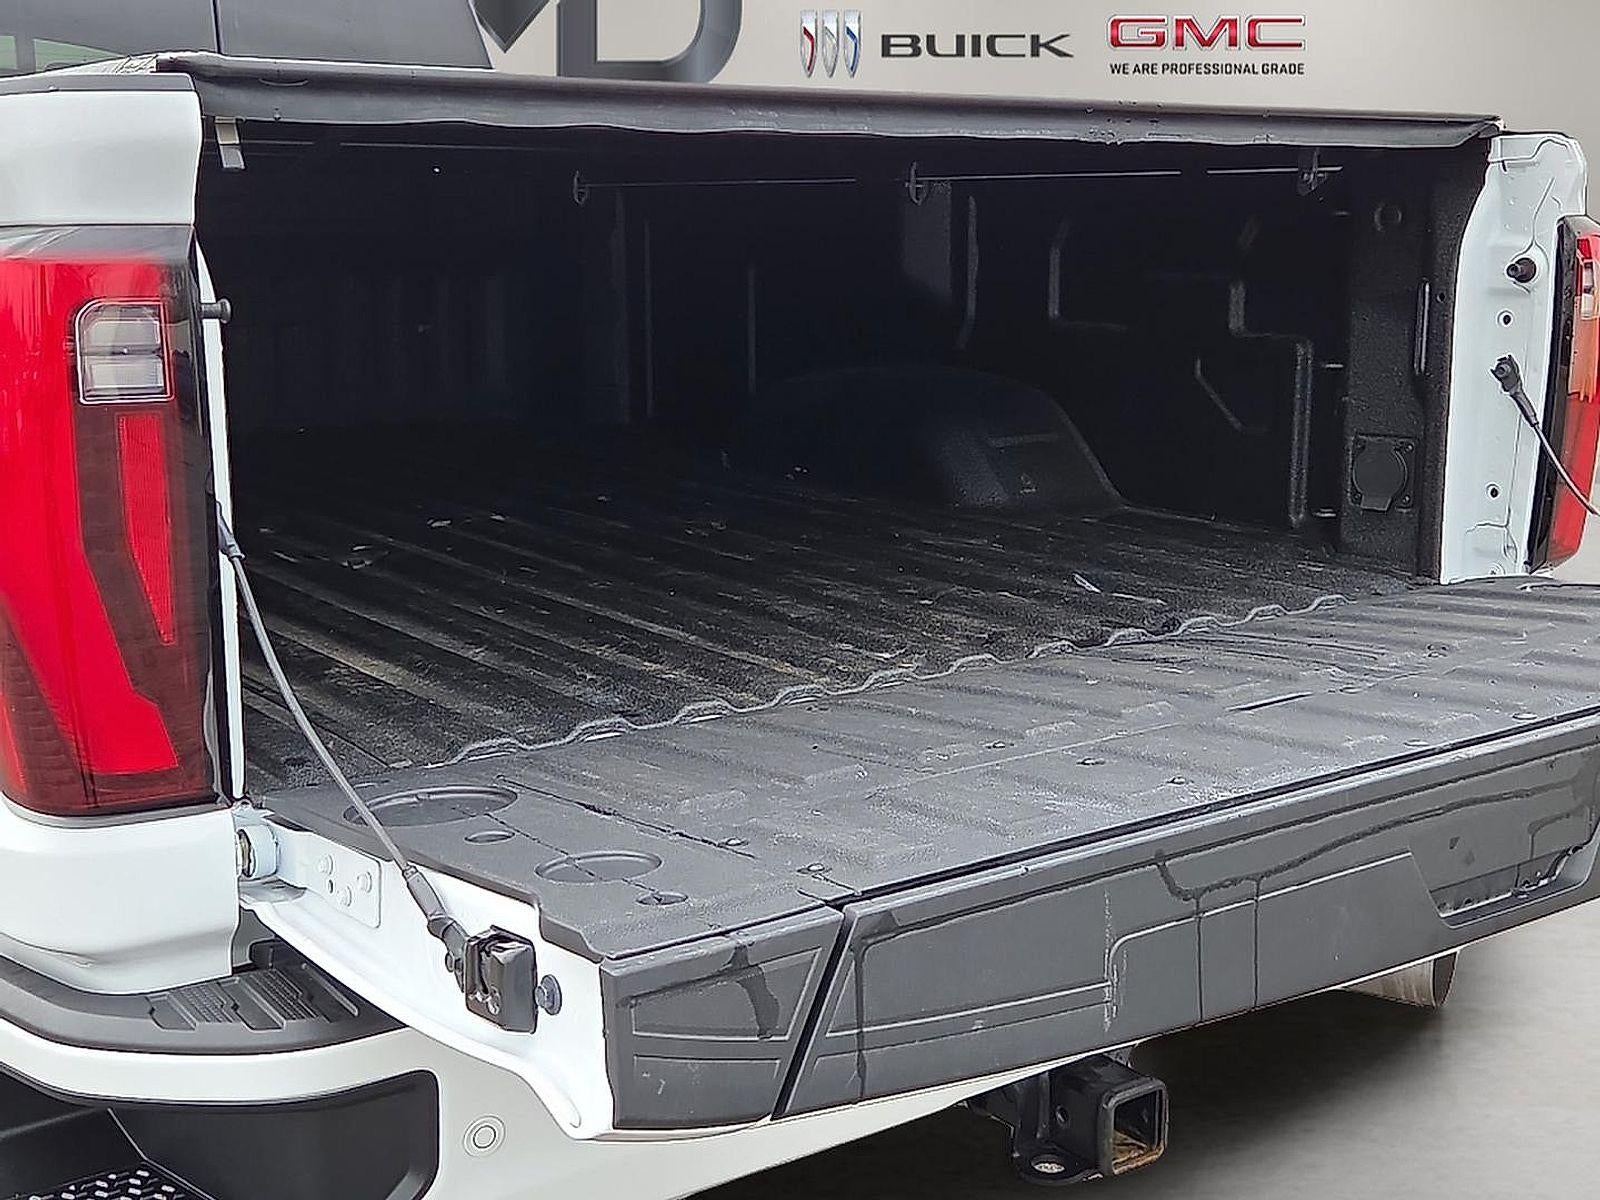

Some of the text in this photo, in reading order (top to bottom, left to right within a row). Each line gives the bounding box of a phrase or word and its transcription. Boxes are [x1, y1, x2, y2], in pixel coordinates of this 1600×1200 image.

[881, 33, 1075, 58] BUICK
[1108, 15, 1306, 51] GMC
[1109, 63, 1305, 75] WE ARE PROFESSIONAL GRADE
